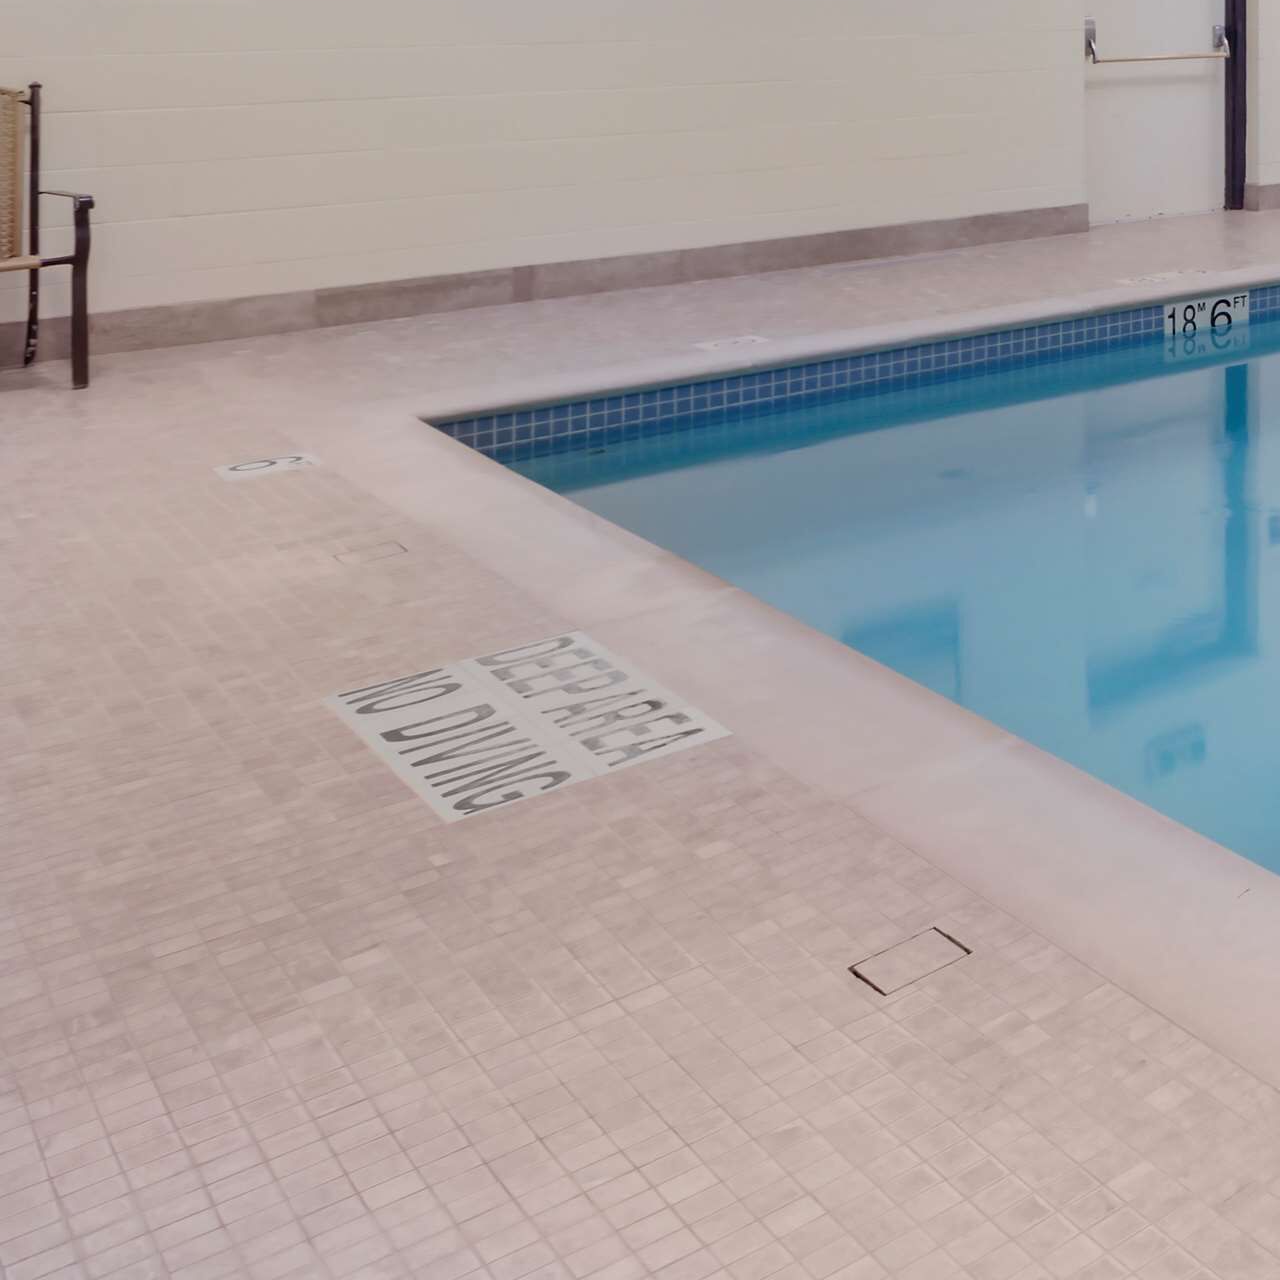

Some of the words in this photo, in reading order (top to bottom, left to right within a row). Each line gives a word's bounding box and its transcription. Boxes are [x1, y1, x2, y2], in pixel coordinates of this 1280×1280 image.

[338, 668, 462, 714] NO
[475, 637, 629, 699] DEEP
[380, 703, 571, 815] DIVING
[541, 689, 704, 767] AREA
